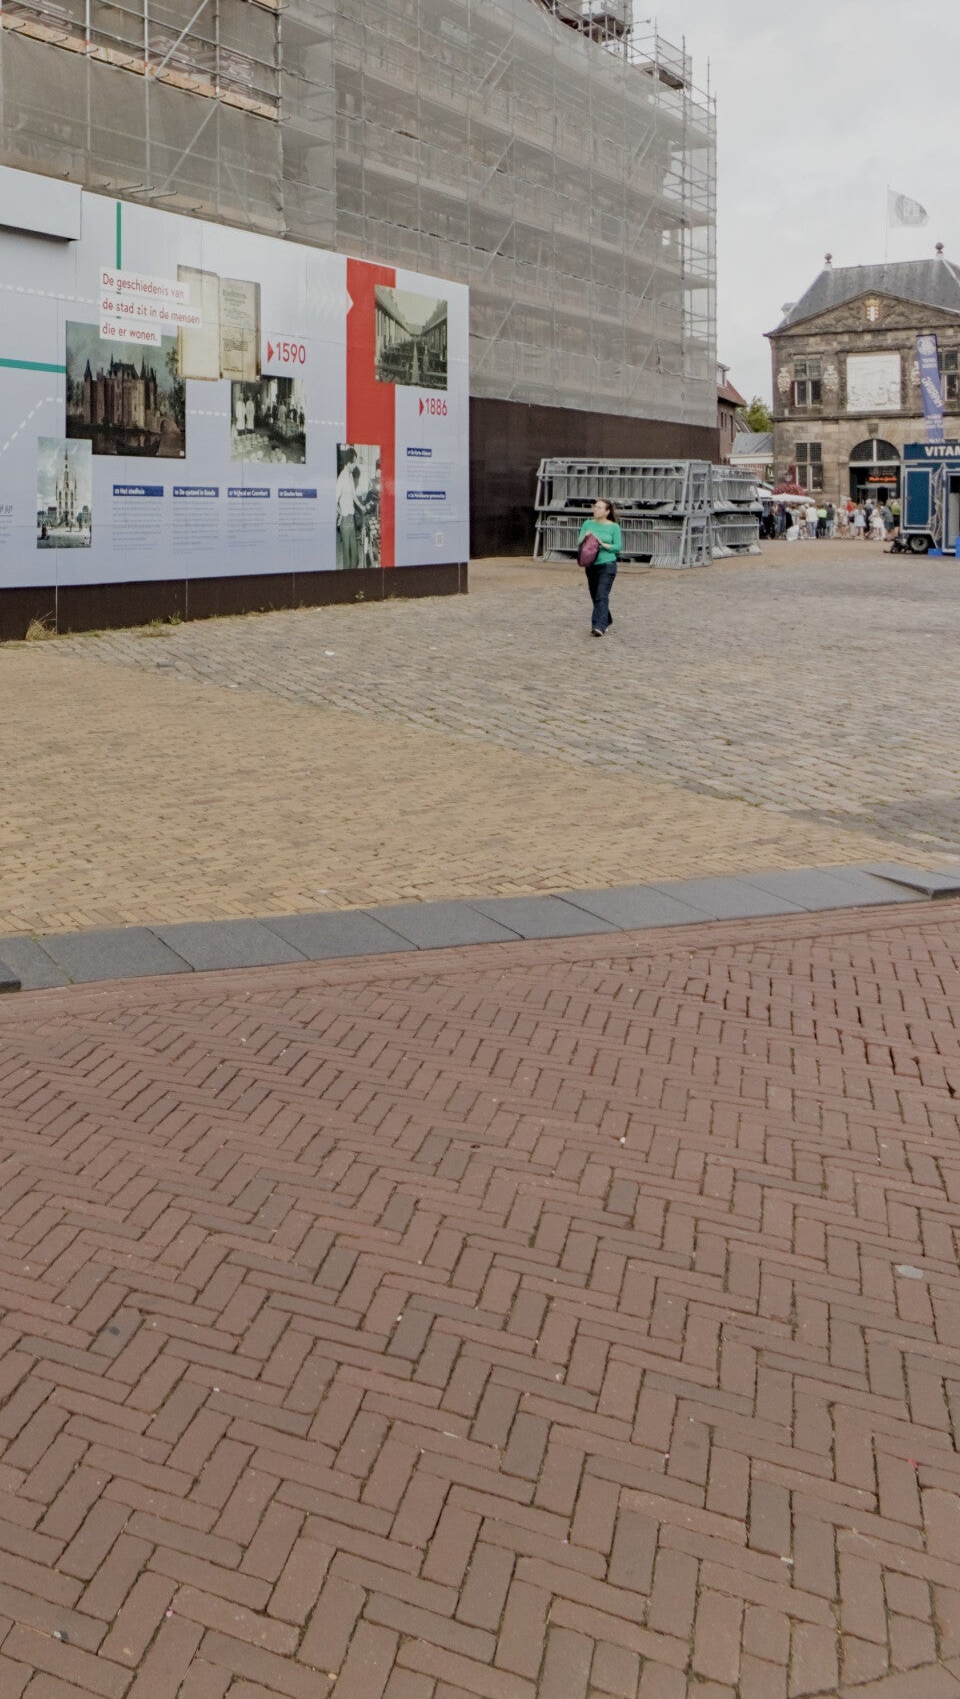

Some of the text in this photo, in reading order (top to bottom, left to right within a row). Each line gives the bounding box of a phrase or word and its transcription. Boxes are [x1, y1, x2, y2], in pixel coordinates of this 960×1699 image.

[103, 273, 184, 299] De geschiedenis van
[102, 297, 200, 324] de stad zit in de mensen
[102, 322, 158, 341] die er wonen.
[276, 342, 306, 364] 1590
[426, 398, 447, 416] 1886
